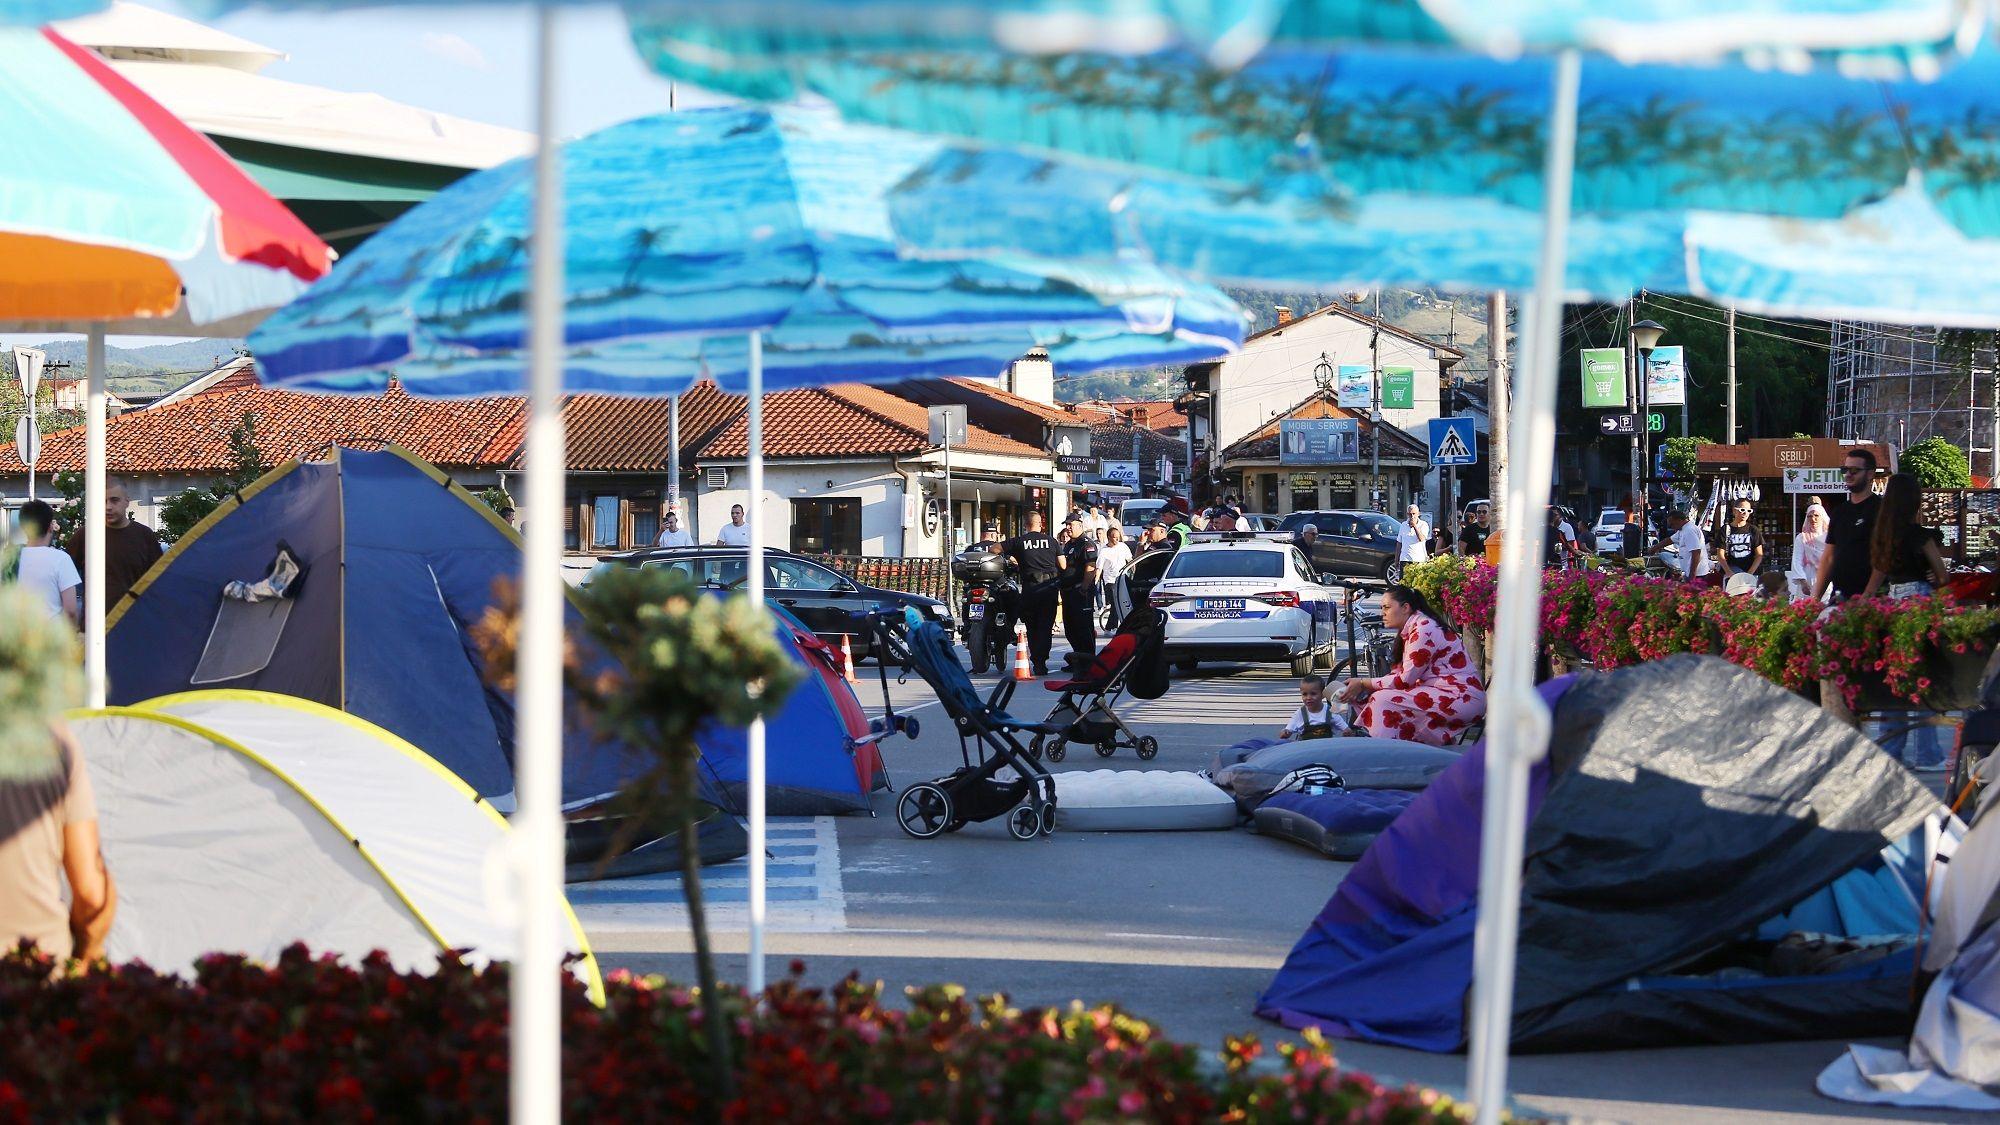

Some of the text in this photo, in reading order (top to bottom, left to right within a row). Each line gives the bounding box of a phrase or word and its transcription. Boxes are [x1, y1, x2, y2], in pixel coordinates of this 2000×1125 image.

[1288, 421, 1348, 430] MOBIL SERVIS
[1780, 451, 1807, 461] SEBILJ
